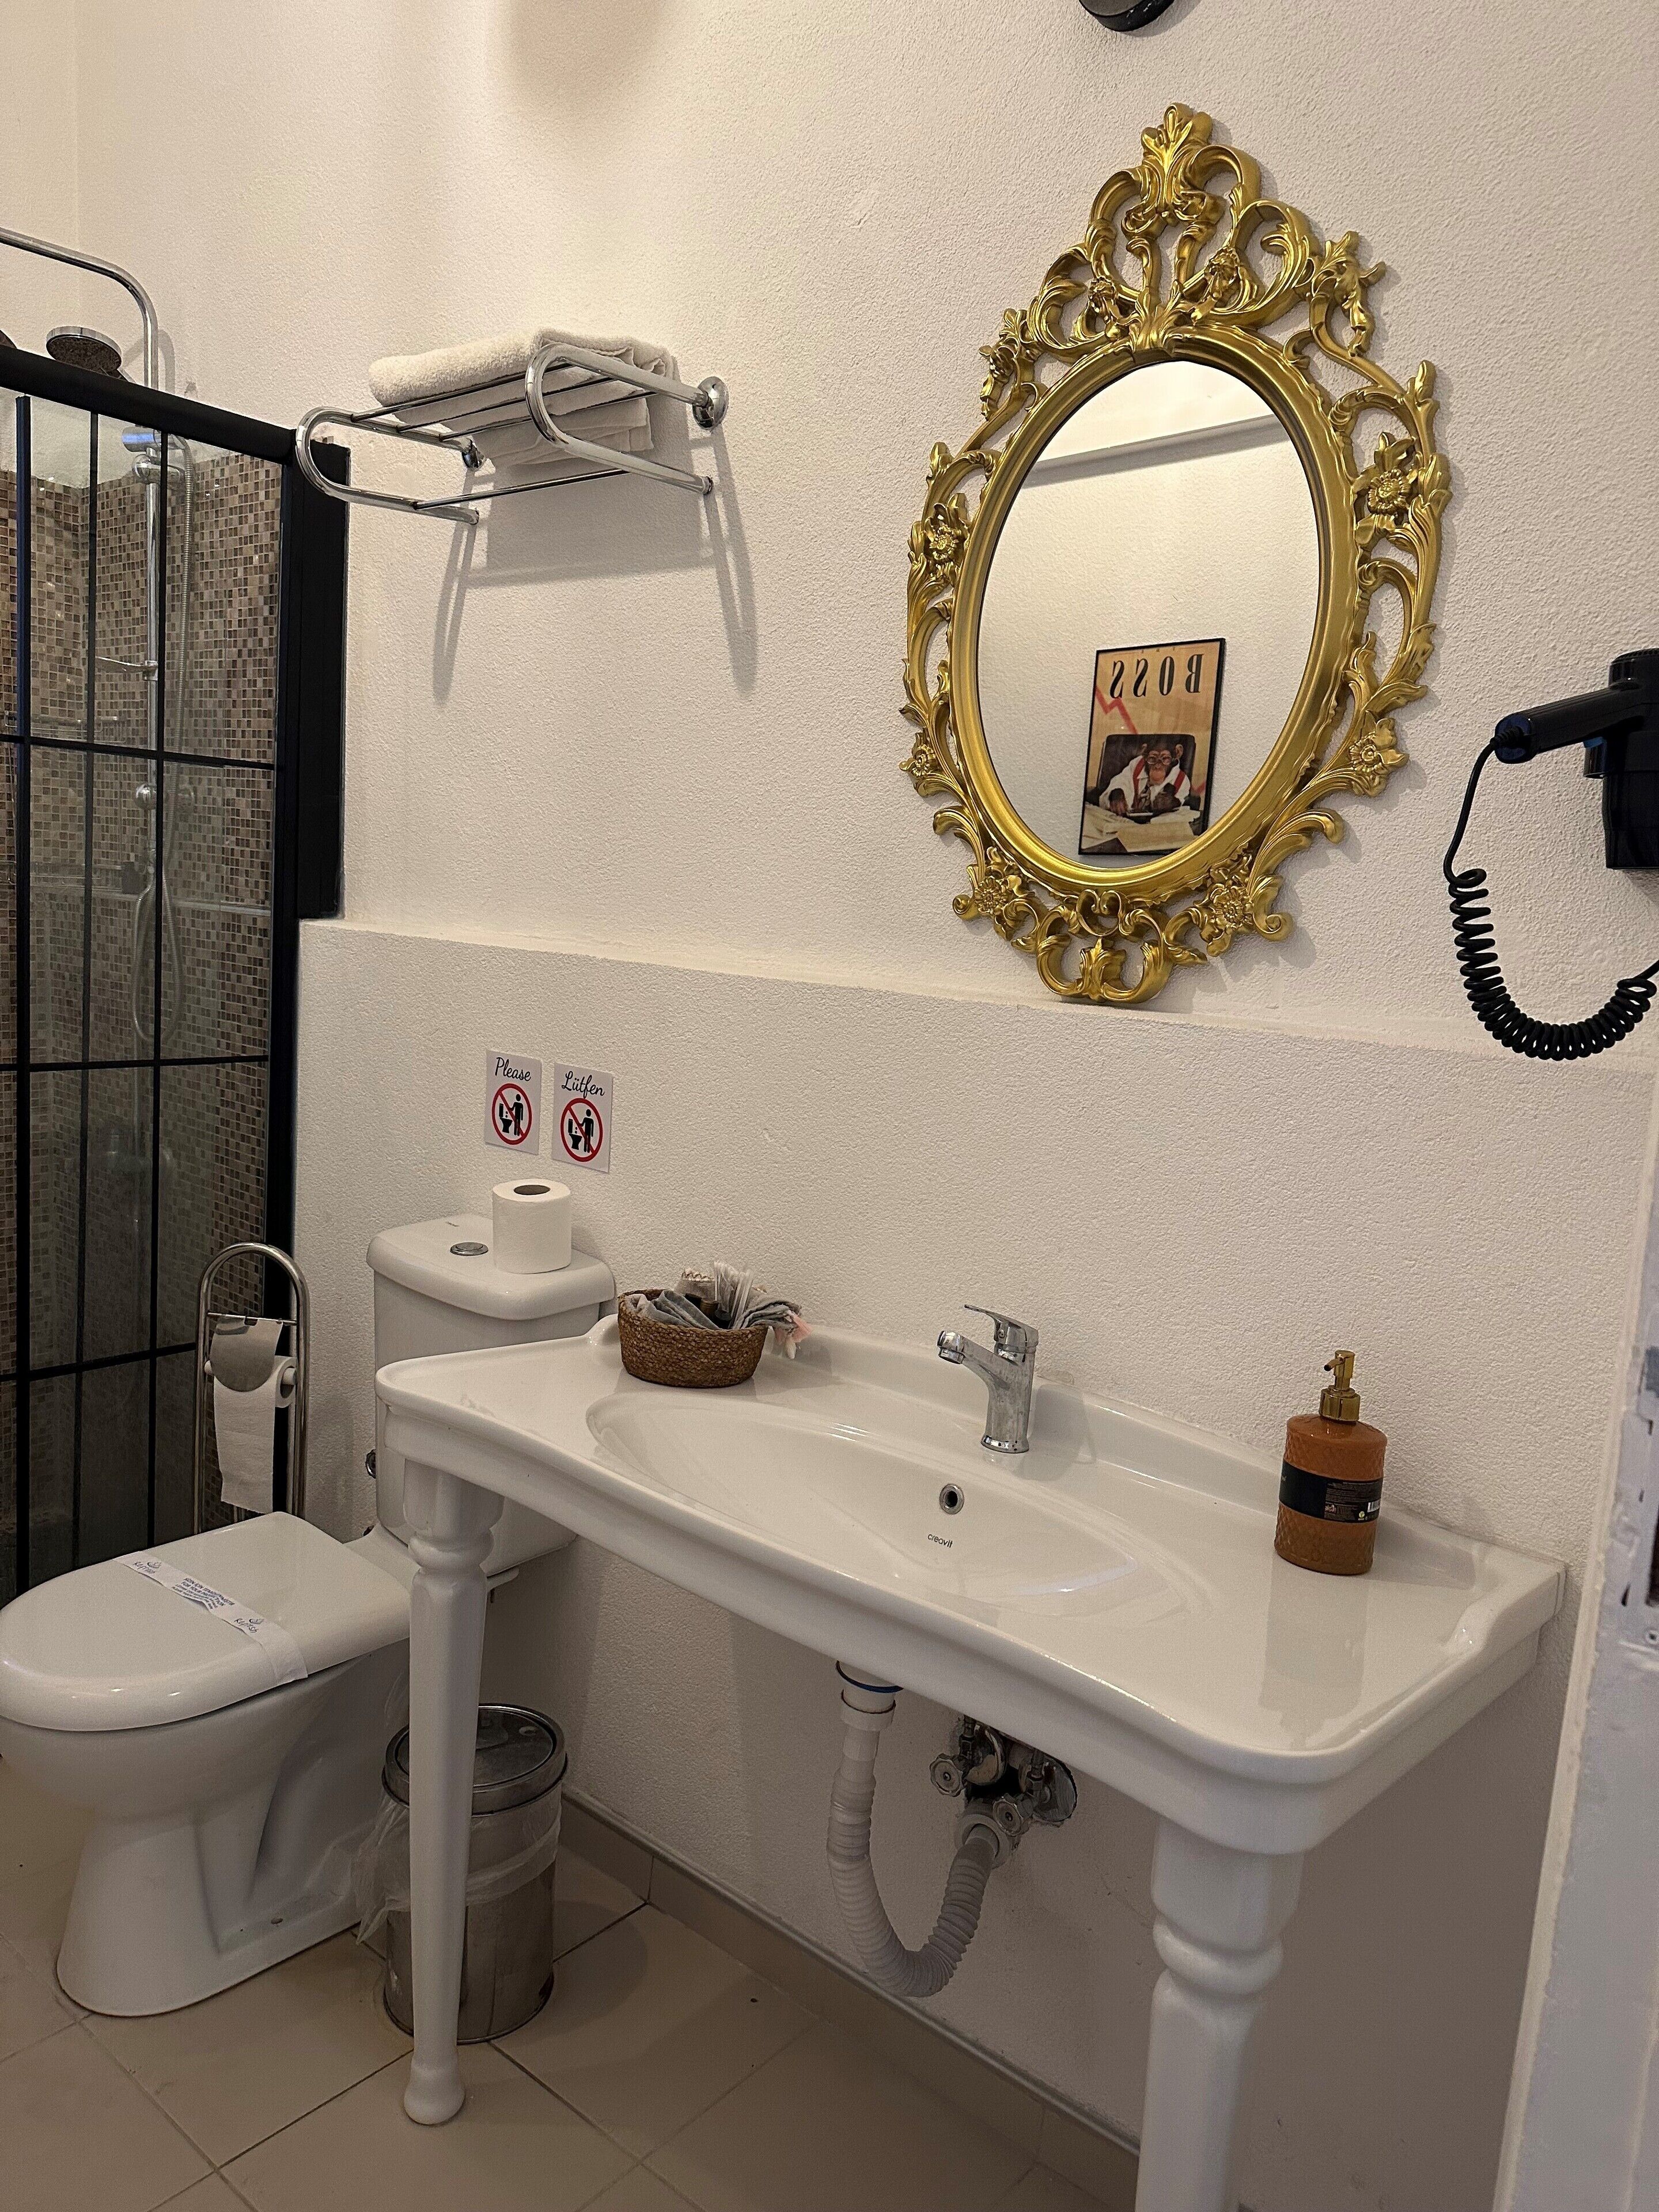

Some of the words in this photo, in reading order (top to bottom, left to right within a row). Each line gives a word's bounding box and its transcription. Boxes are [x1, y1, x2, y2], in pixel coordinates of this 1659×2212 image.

[494, 1056, 532, 1081] Please
[561, 1070, 605, 1099] Lütfen
[927, 1534, 953, 1548] creavit
